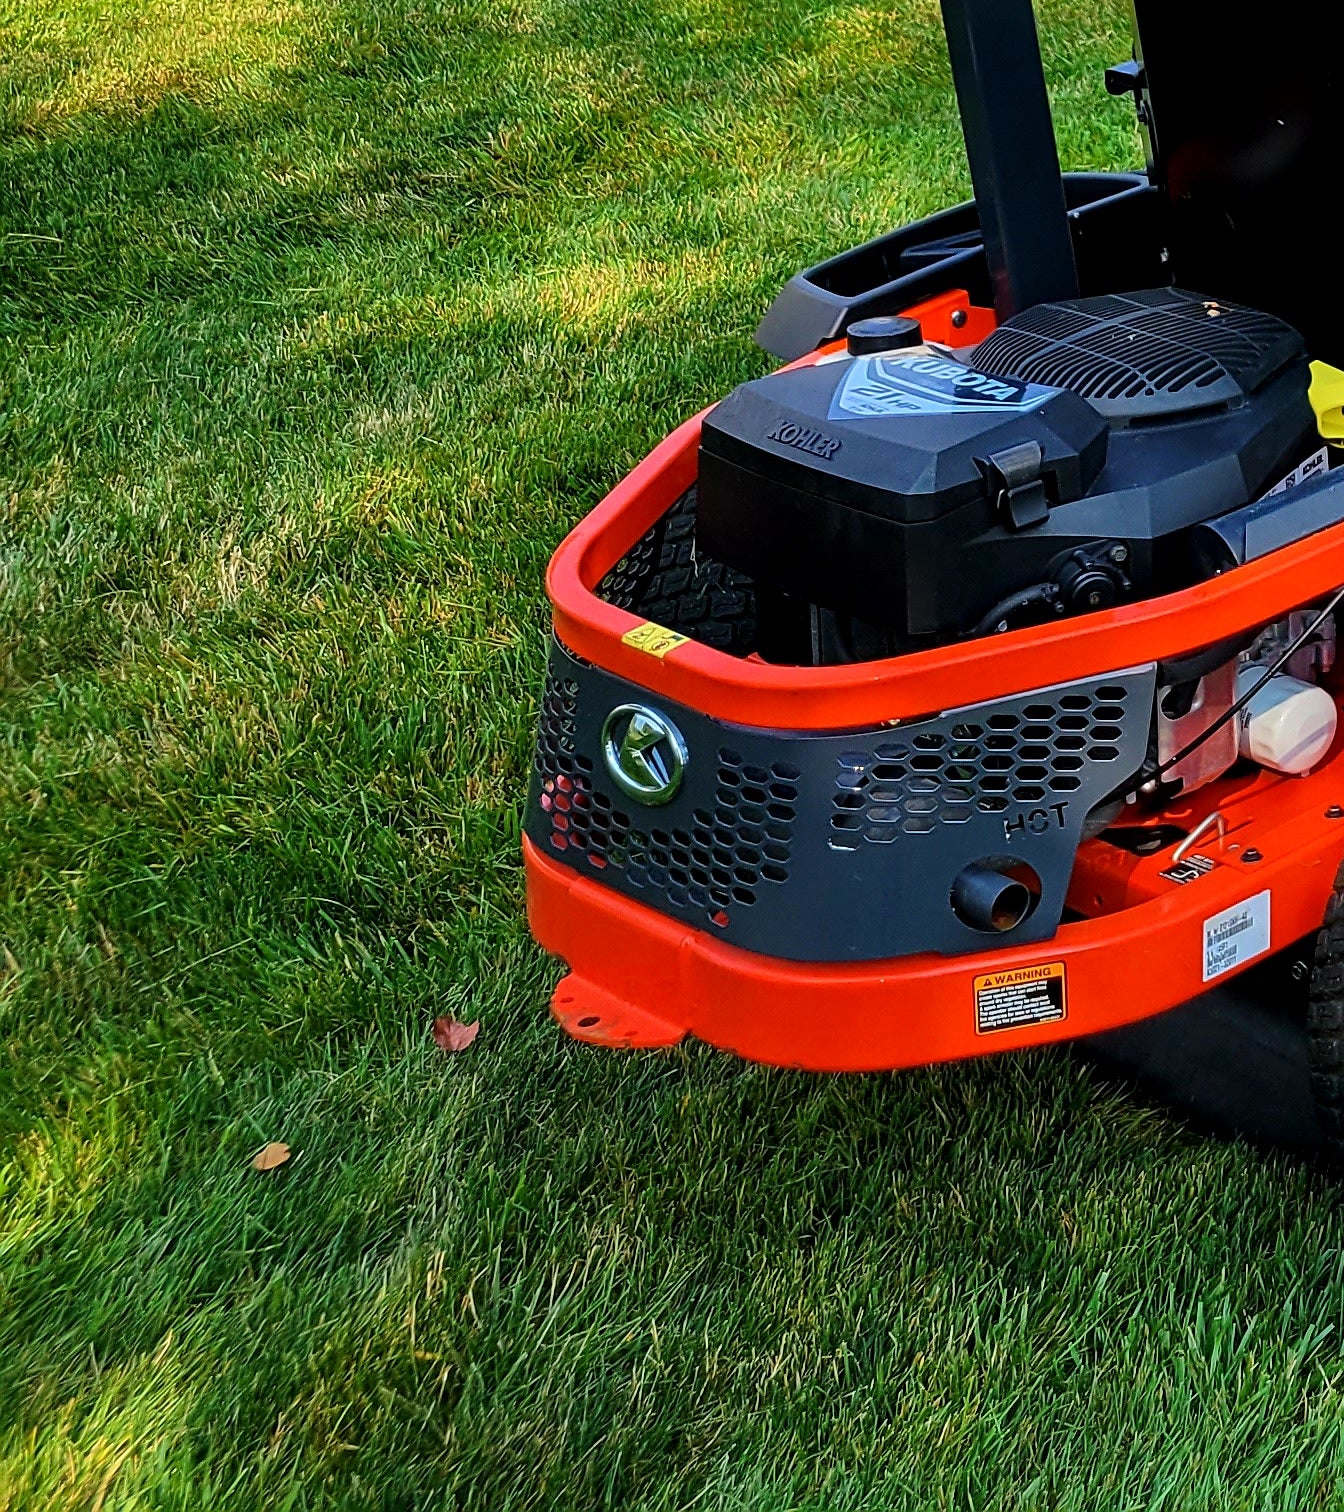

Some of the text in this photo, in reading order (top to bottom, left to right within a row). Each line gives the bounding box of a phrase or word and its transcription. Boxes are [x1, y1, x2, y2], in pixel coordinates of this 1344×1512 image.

[889, 357, 1020, 401] KUBOTA
[767, 420, 842, 460] KOHLER
[1003, 800, 1070, 842] HOT
[994, 967, 1052, 986] WARNING
